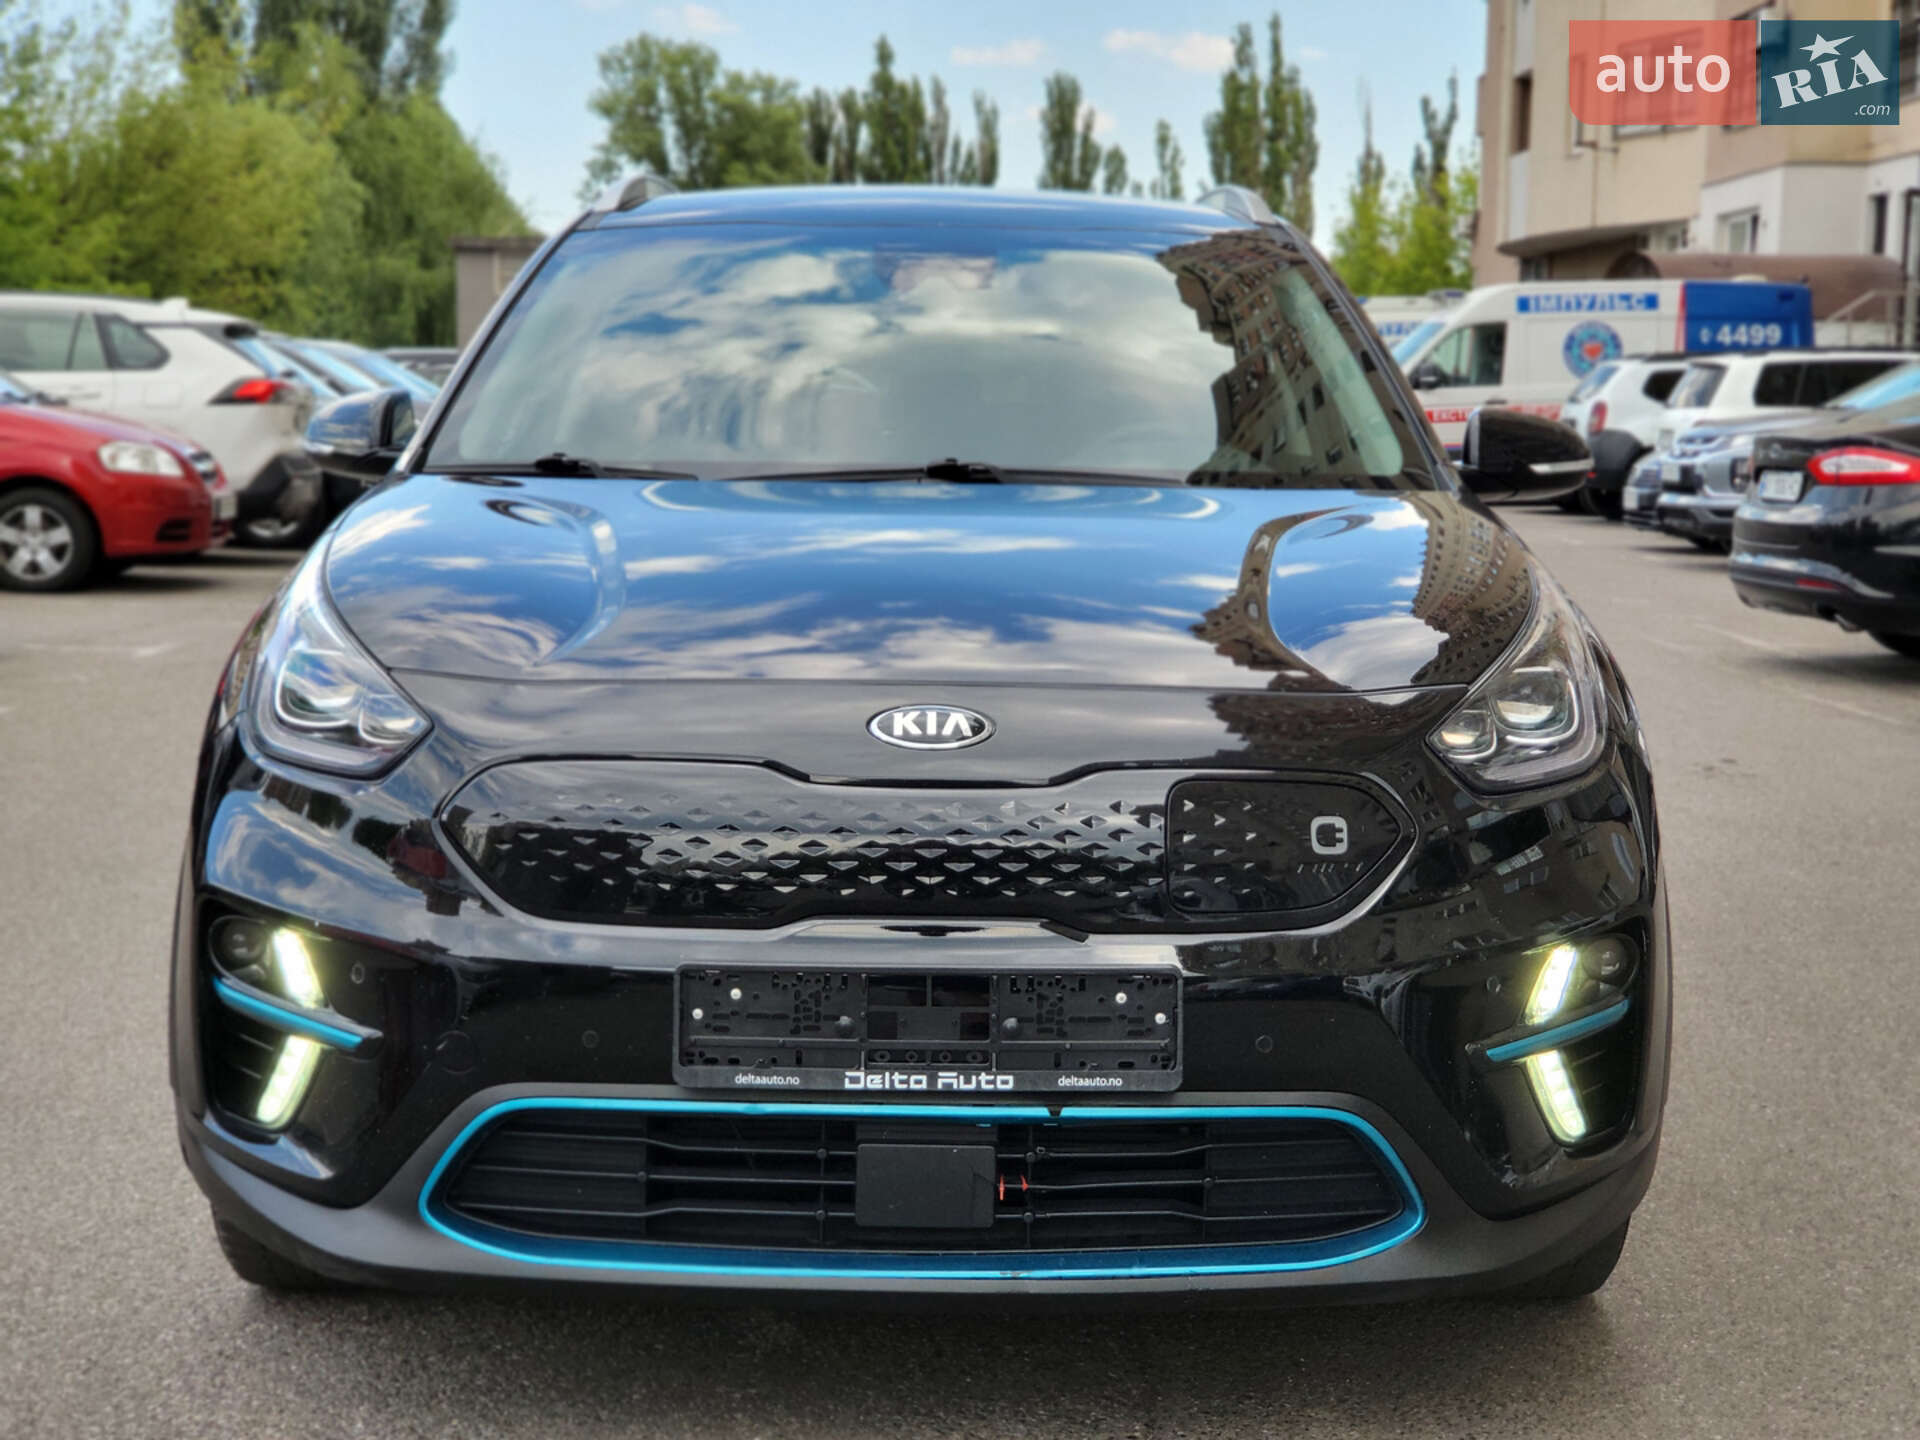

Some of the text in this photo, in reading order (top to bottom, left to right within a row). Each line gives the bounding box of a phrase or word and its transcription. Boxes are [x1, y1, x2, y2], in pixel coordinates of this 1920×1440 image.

[1716, 323, 1782, 346] 4499
[893, 711, 973, 737] KIA
[734, 1073, 800, 1086] deltaauto.no
[844, 1071, 1014, 1090] Delta Auto
[1057, 1074, 1123, 1087] deltaauto.no
